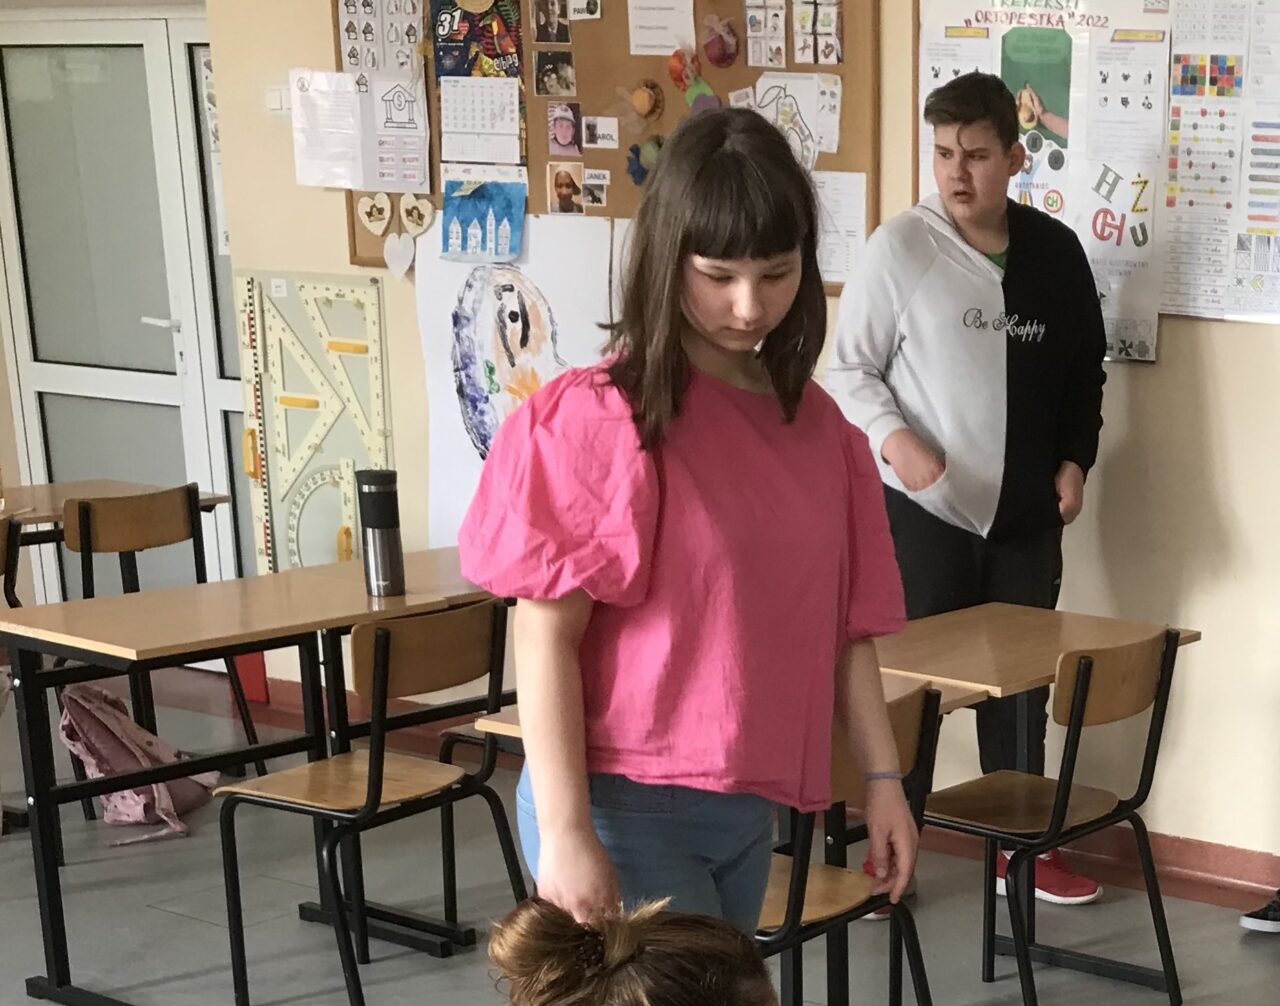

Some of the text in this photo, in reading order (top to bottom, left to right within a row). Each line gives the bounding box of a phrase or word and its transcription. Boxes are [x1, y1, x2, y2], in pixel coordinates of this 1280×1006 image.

[1078, 15, 1110, 28] 2022
[963, 307, 1046, 342] Be Happy
